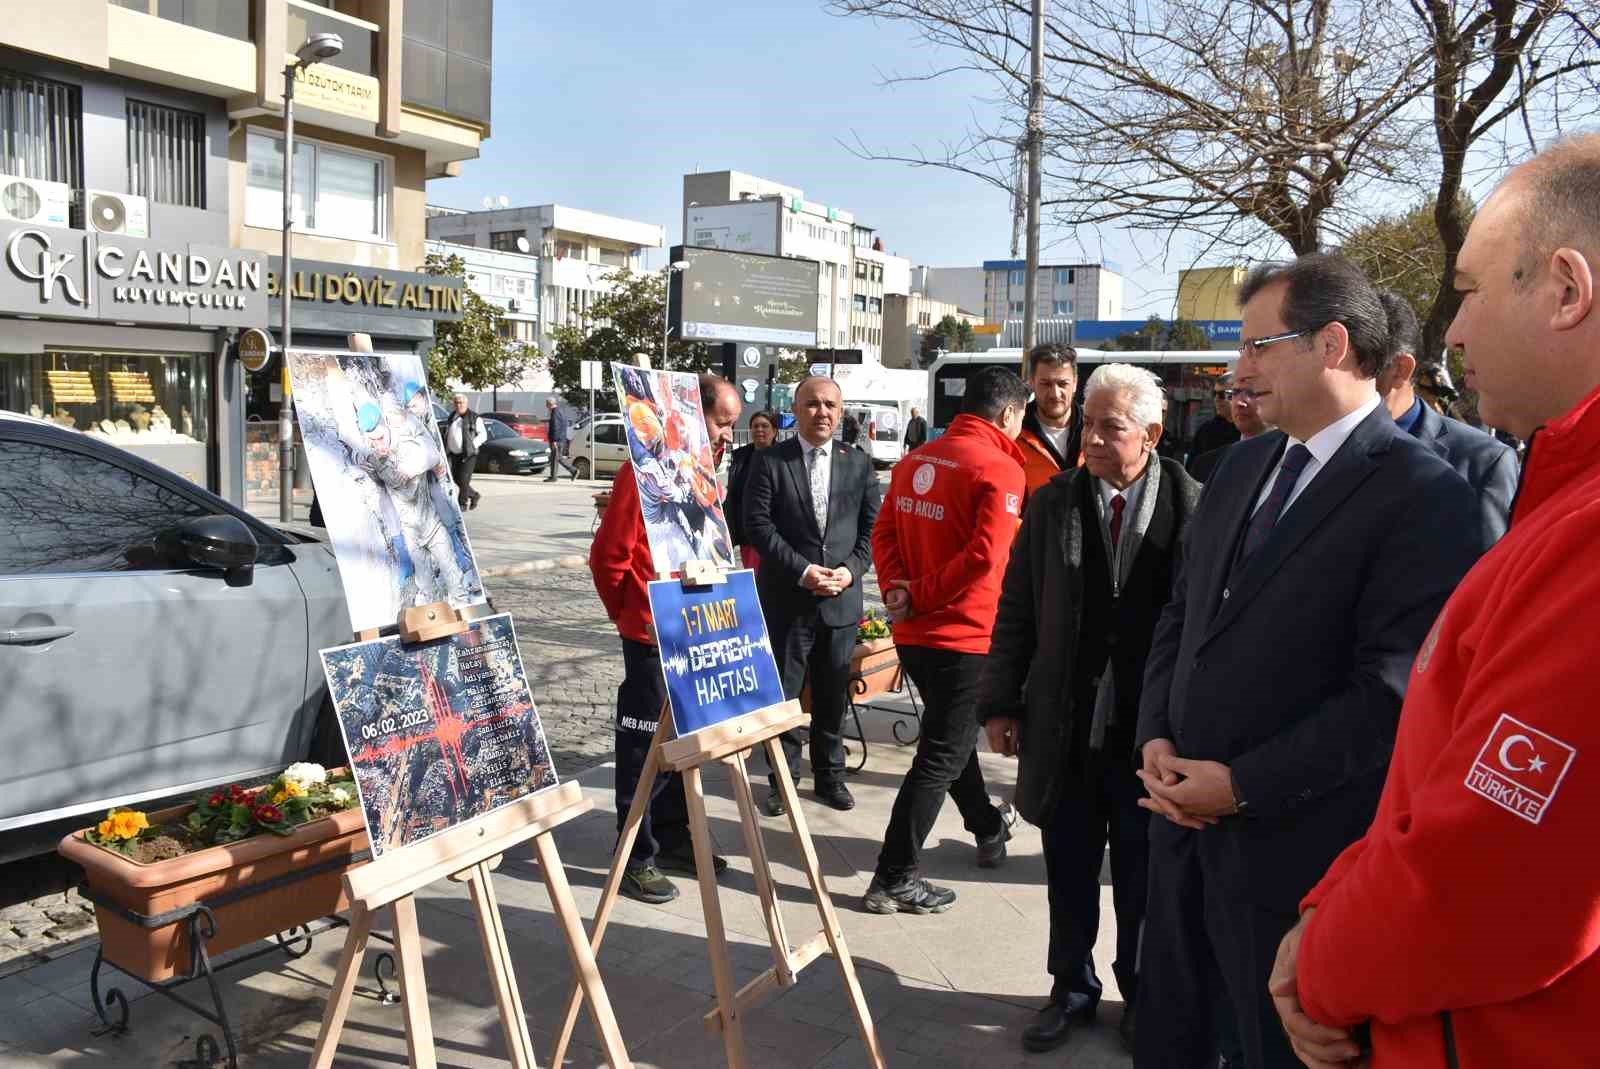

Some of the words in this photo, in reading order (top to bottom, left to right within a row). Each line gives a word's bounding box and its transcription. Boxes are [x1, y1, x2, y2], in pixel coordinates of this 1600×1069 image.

[97, 246, 261, 288] CANDAN
[115, 286, 247, 308] KUYUMCULUK
[324, 272, 397, 306] DÖVİZ
[401, 283, 463, 312] ALTIN
[895, 495, 914, 512] MEB
[915, 501, 944, 521] AKUB
[681, 605, 703, 637] 1-7
[702, 598, 738, 633] MART
[459, 658, 482, 671] Hatay
[688, 634, 753, 672] DEPREM
[695, 664, 759, 706] HAFTASI
[361, 709, 429, 739] 06.02.2023
[621, 715, 637, 729] MEB
[1471, 769, 1541, 818] TÜRKİYE
